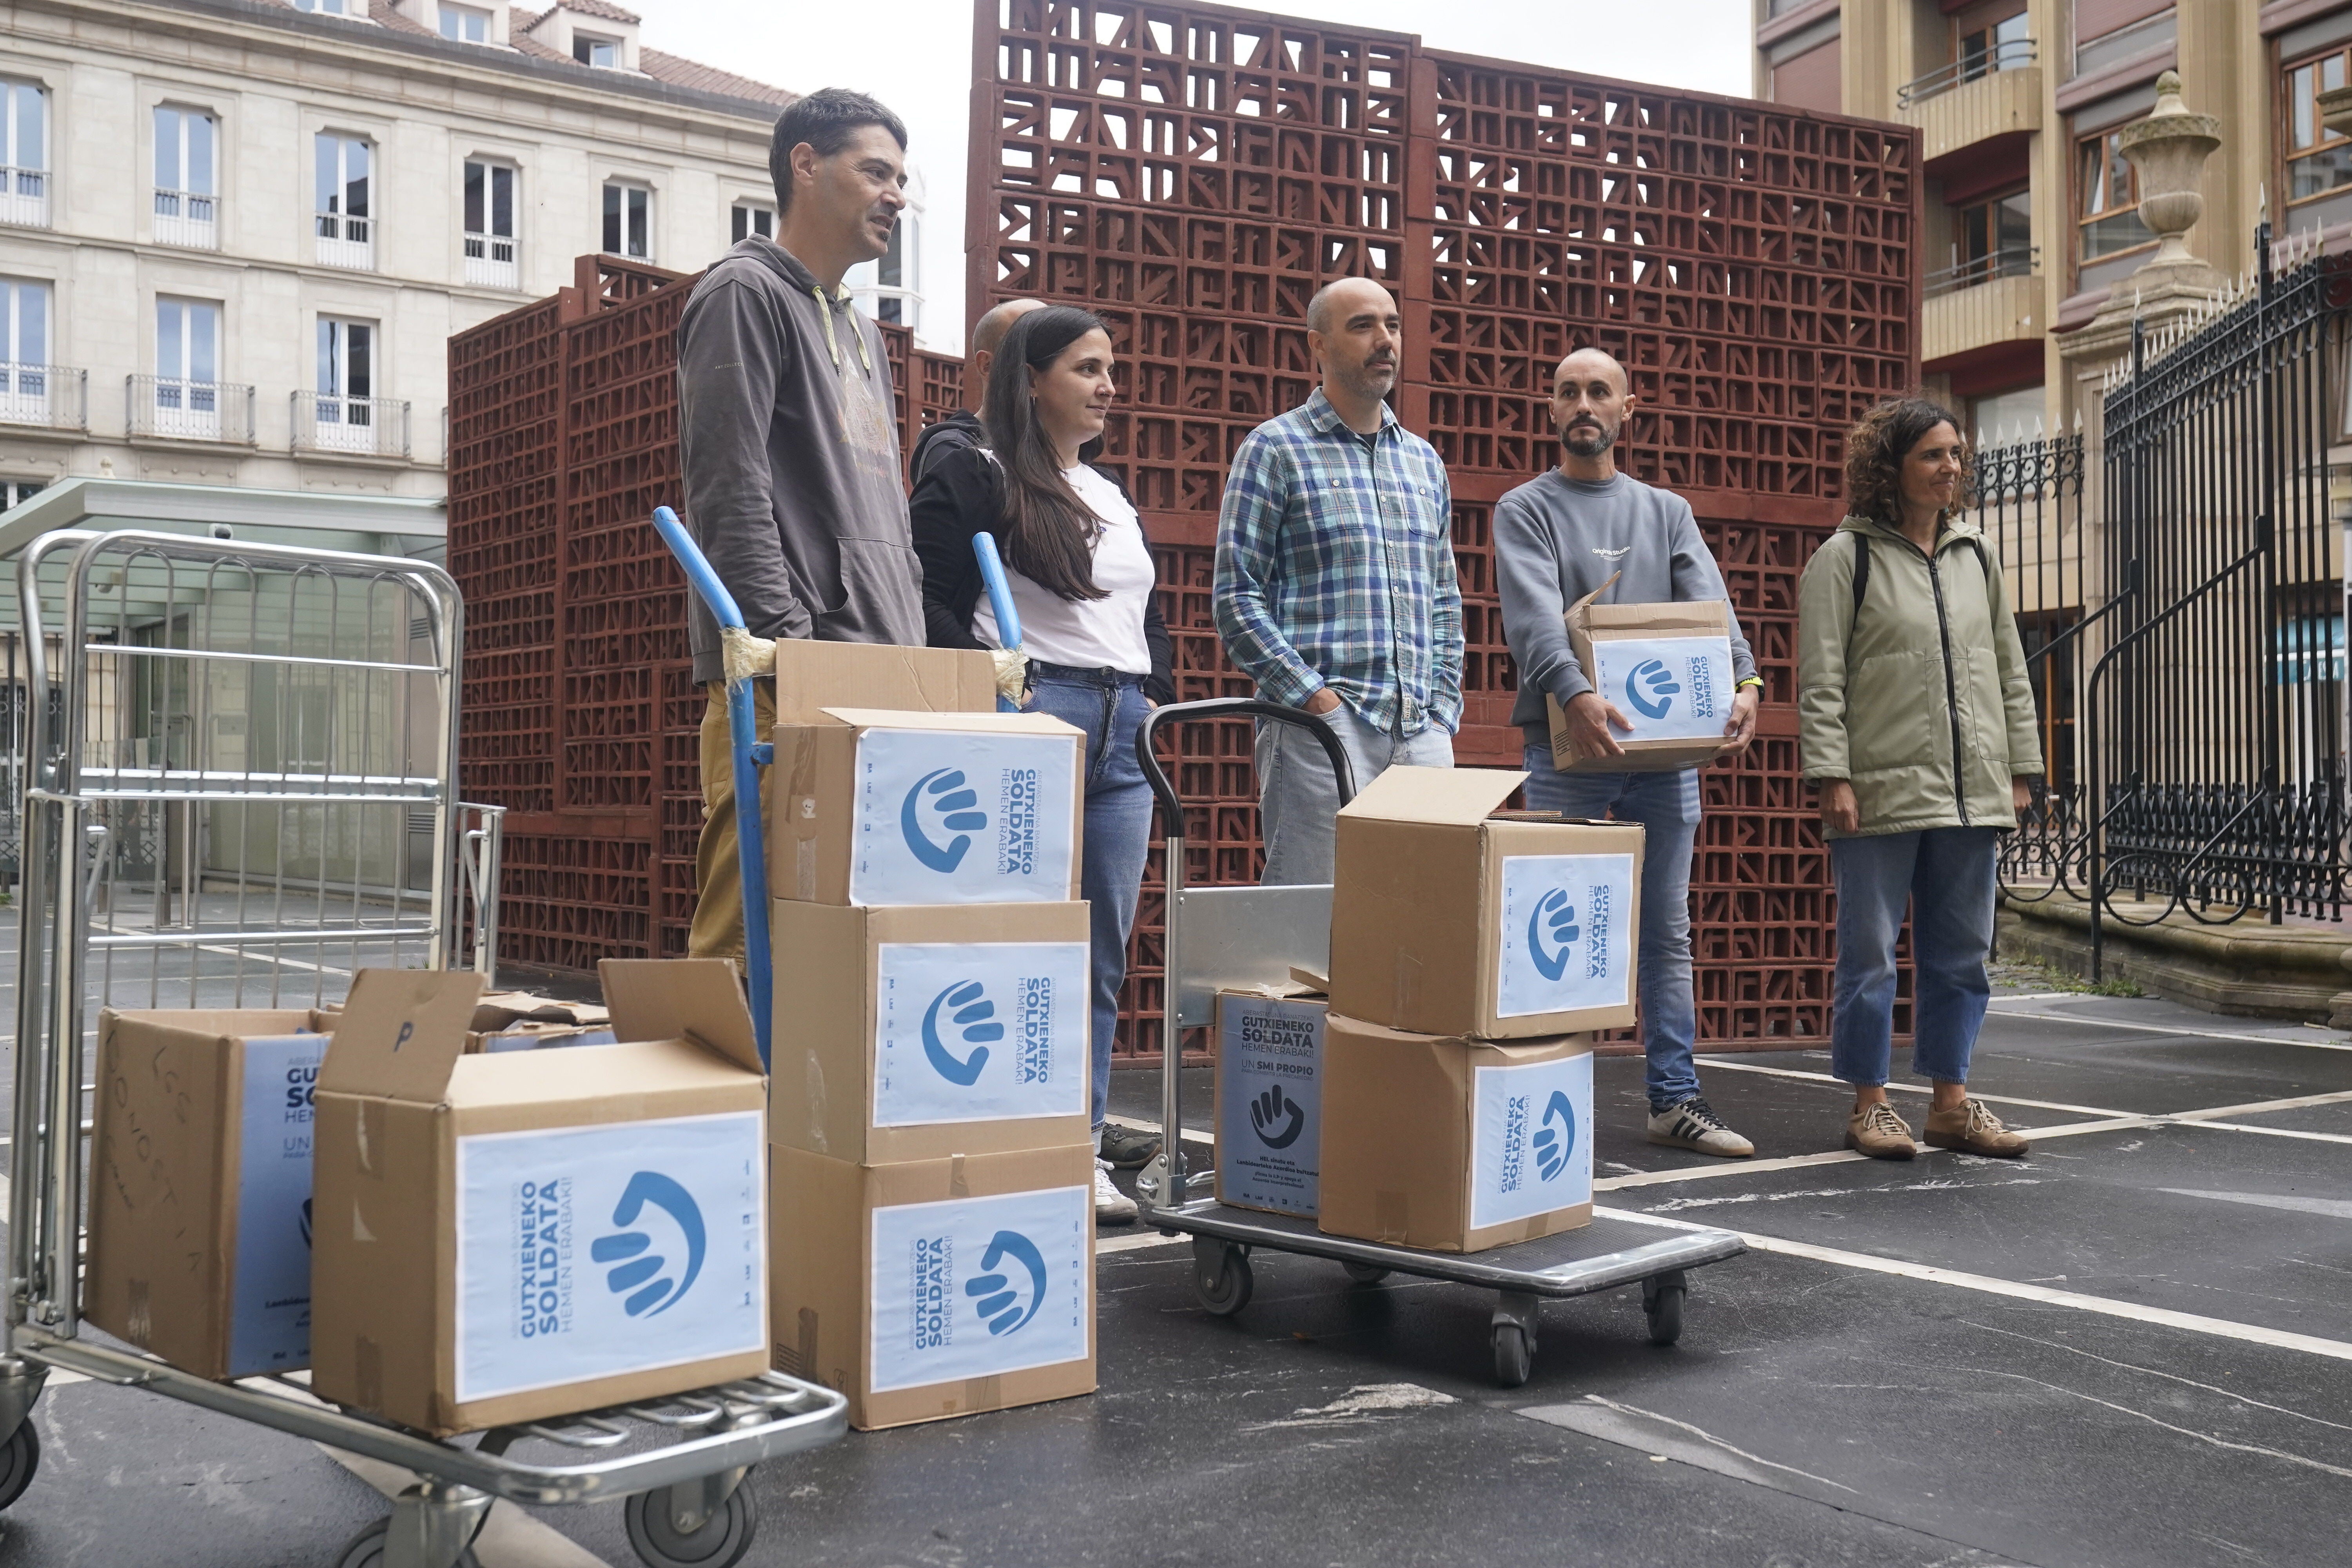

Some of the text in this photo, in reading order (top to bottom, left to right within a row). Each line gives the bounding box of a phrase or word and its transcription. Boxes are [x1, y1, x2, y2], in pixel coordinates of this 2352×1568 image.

[1613, 546, 1630, 555] Studio
[1688, 685, 1696, 718] ERABAKI!
[1691, 657, 1705, 718] SOLDATA
[1701, 656, 1713, 717] GUTXIENEKO
[998, 769, 1010, 874] HEMEN ERABAKI!
[1007, 769, 1024, 874] SOLDATA
[1022, 769, 1036, 874] GUTXIENEKO
[1591, 886, 1602, 978] SOLDATA
[1600, 885, 1609, 978] GUTXIENEKO
[1015, 978, 1025, 1085] HEMEN ERABAKI!
[1024, 978, 1039, 1083] SOLDATA
[1038, 977, 1050, 1083] GUTXIENEKO
[1242, 1016, 1314, 1033] GUTXIENEKO
[1242, 1028, 1313, 1048] SOLDATA
[1242, 1043, 1313, 1058] HEMEN ERABAKI!
[1242, 1059, 1313, 1076] UN SMI PROPIO
[1237, 1160, 1272, 1169] Lanbidearteko
[1501, 1097, 1515, 1193] GUTXIENEKO
[1508, 1096, 1524, 1191] SOLDATA
[1516, 1095, 1530, 1190] HEMEN ERABAKI!
[521, 1181, 536, 1338] GUTXIENEKO
[539, 1180, 558, 1334] SOLDATA
[561, 1176, 572, 1333] HEMEN ERABAKI!
[916, 1238, 927, 1349] GUTXIENEKO
[928, 1237, 942, 1347] SOLDATA
[944, 1236, 952, 1294] ERABAKI!
